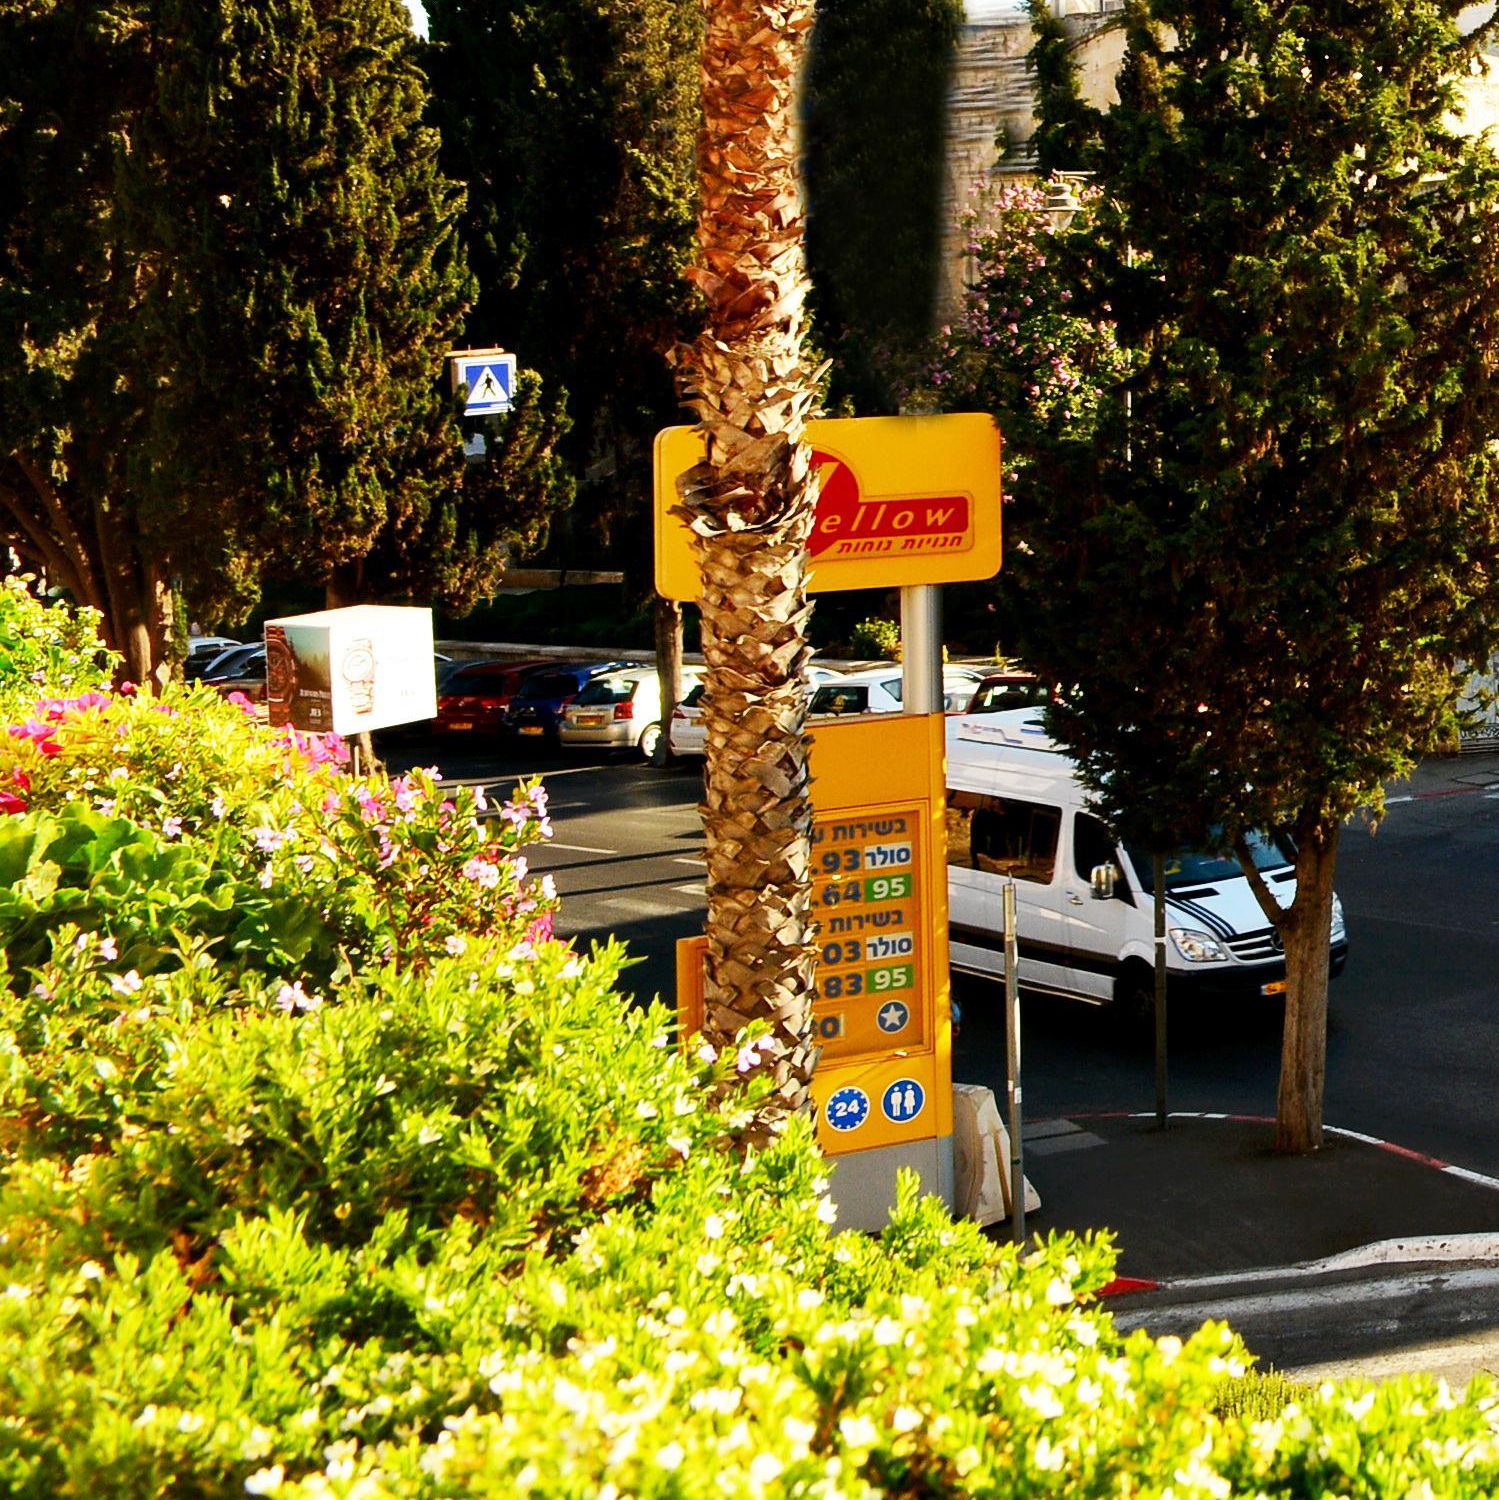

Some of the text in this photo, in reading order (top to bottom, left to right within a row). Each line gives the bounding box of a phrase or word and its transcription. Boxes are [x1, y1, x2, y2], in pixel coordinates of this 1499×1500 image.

[836, 535, 963, 554] חנויות נוחות
[832, 818, 907, 841] בשירות
[811, 846, 911, 875] סולר .93
[812, 877, 906, 908] 95 .64
[829, 909, 904, 934] בשירות
[815, 936, 912, 968] סולר .03
[874, 967, 907, 990] 95
[834, 1100, 860, 1118] 24
